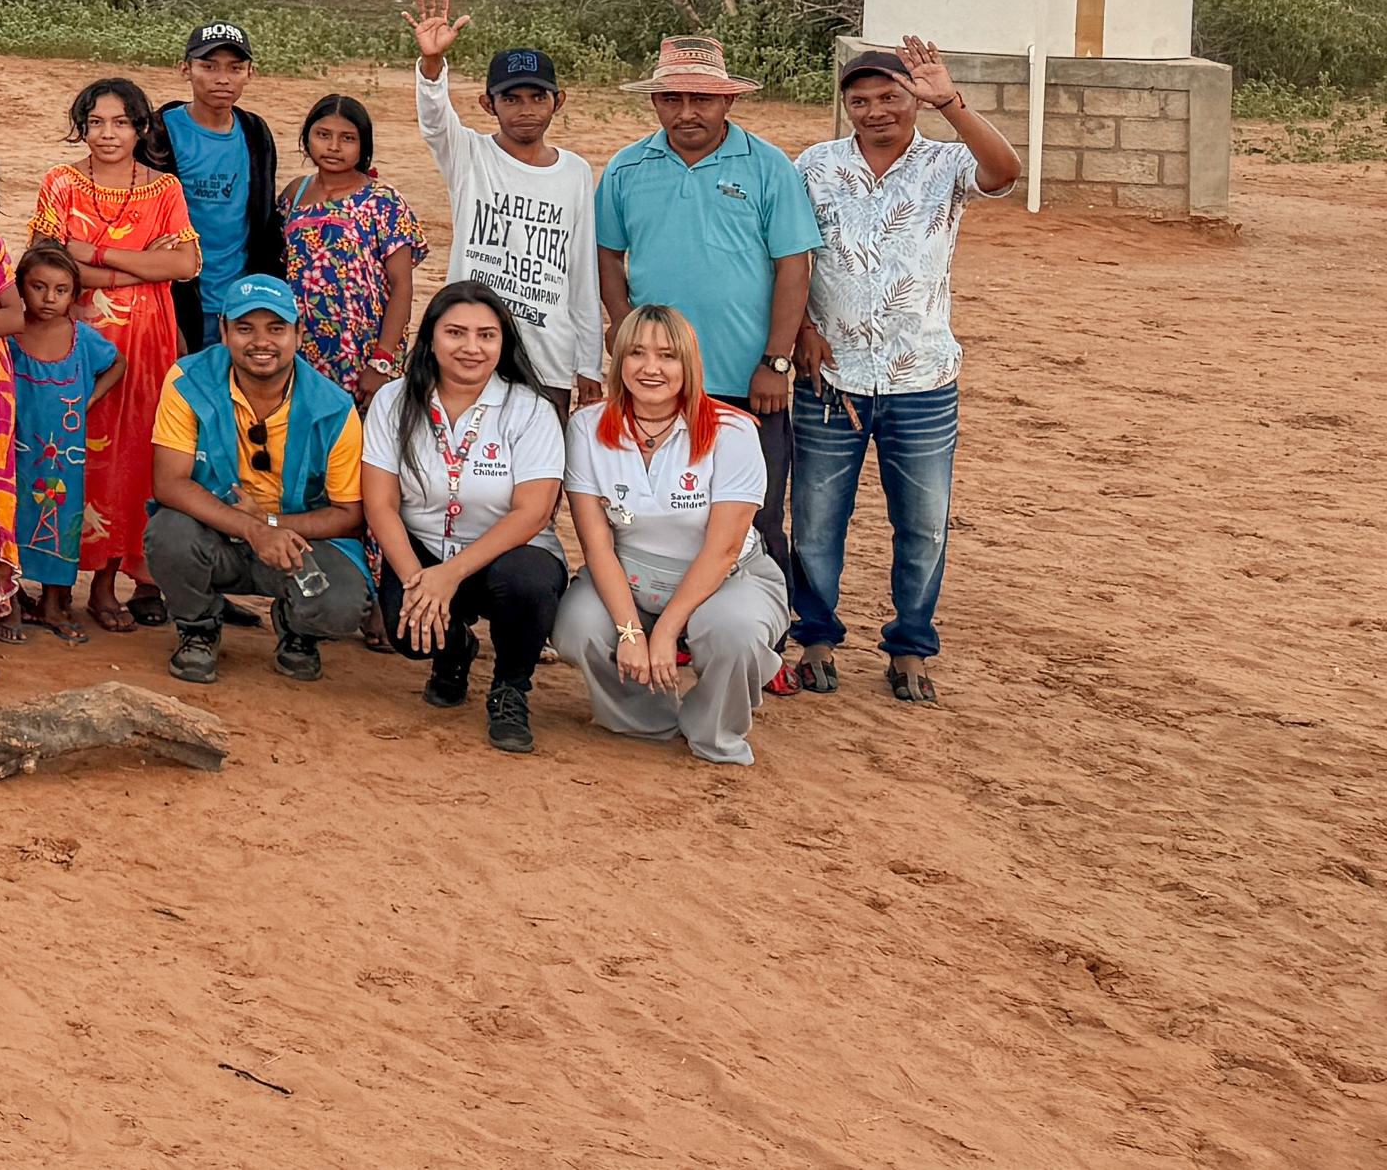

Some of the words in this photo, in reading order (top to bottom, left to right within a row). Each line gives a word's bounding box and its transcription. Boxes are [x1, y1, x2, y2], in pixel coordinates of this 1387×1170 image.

[202, 24, 243, 39] BOSS
[507, 52, 537, 73] 23
[524, 224, 569, 275] YORK
[465, 249, 502, 266] SUPERIOR
[470, 268, 518, 294] ORIGINAL
[520, 284, 560, 306] COMPANY
[473, 460, 493, 469] Save
[472, 468, 508, 477] Children
[670, 492, 691, 501] Save
[670, 500, 707, 509] Children
